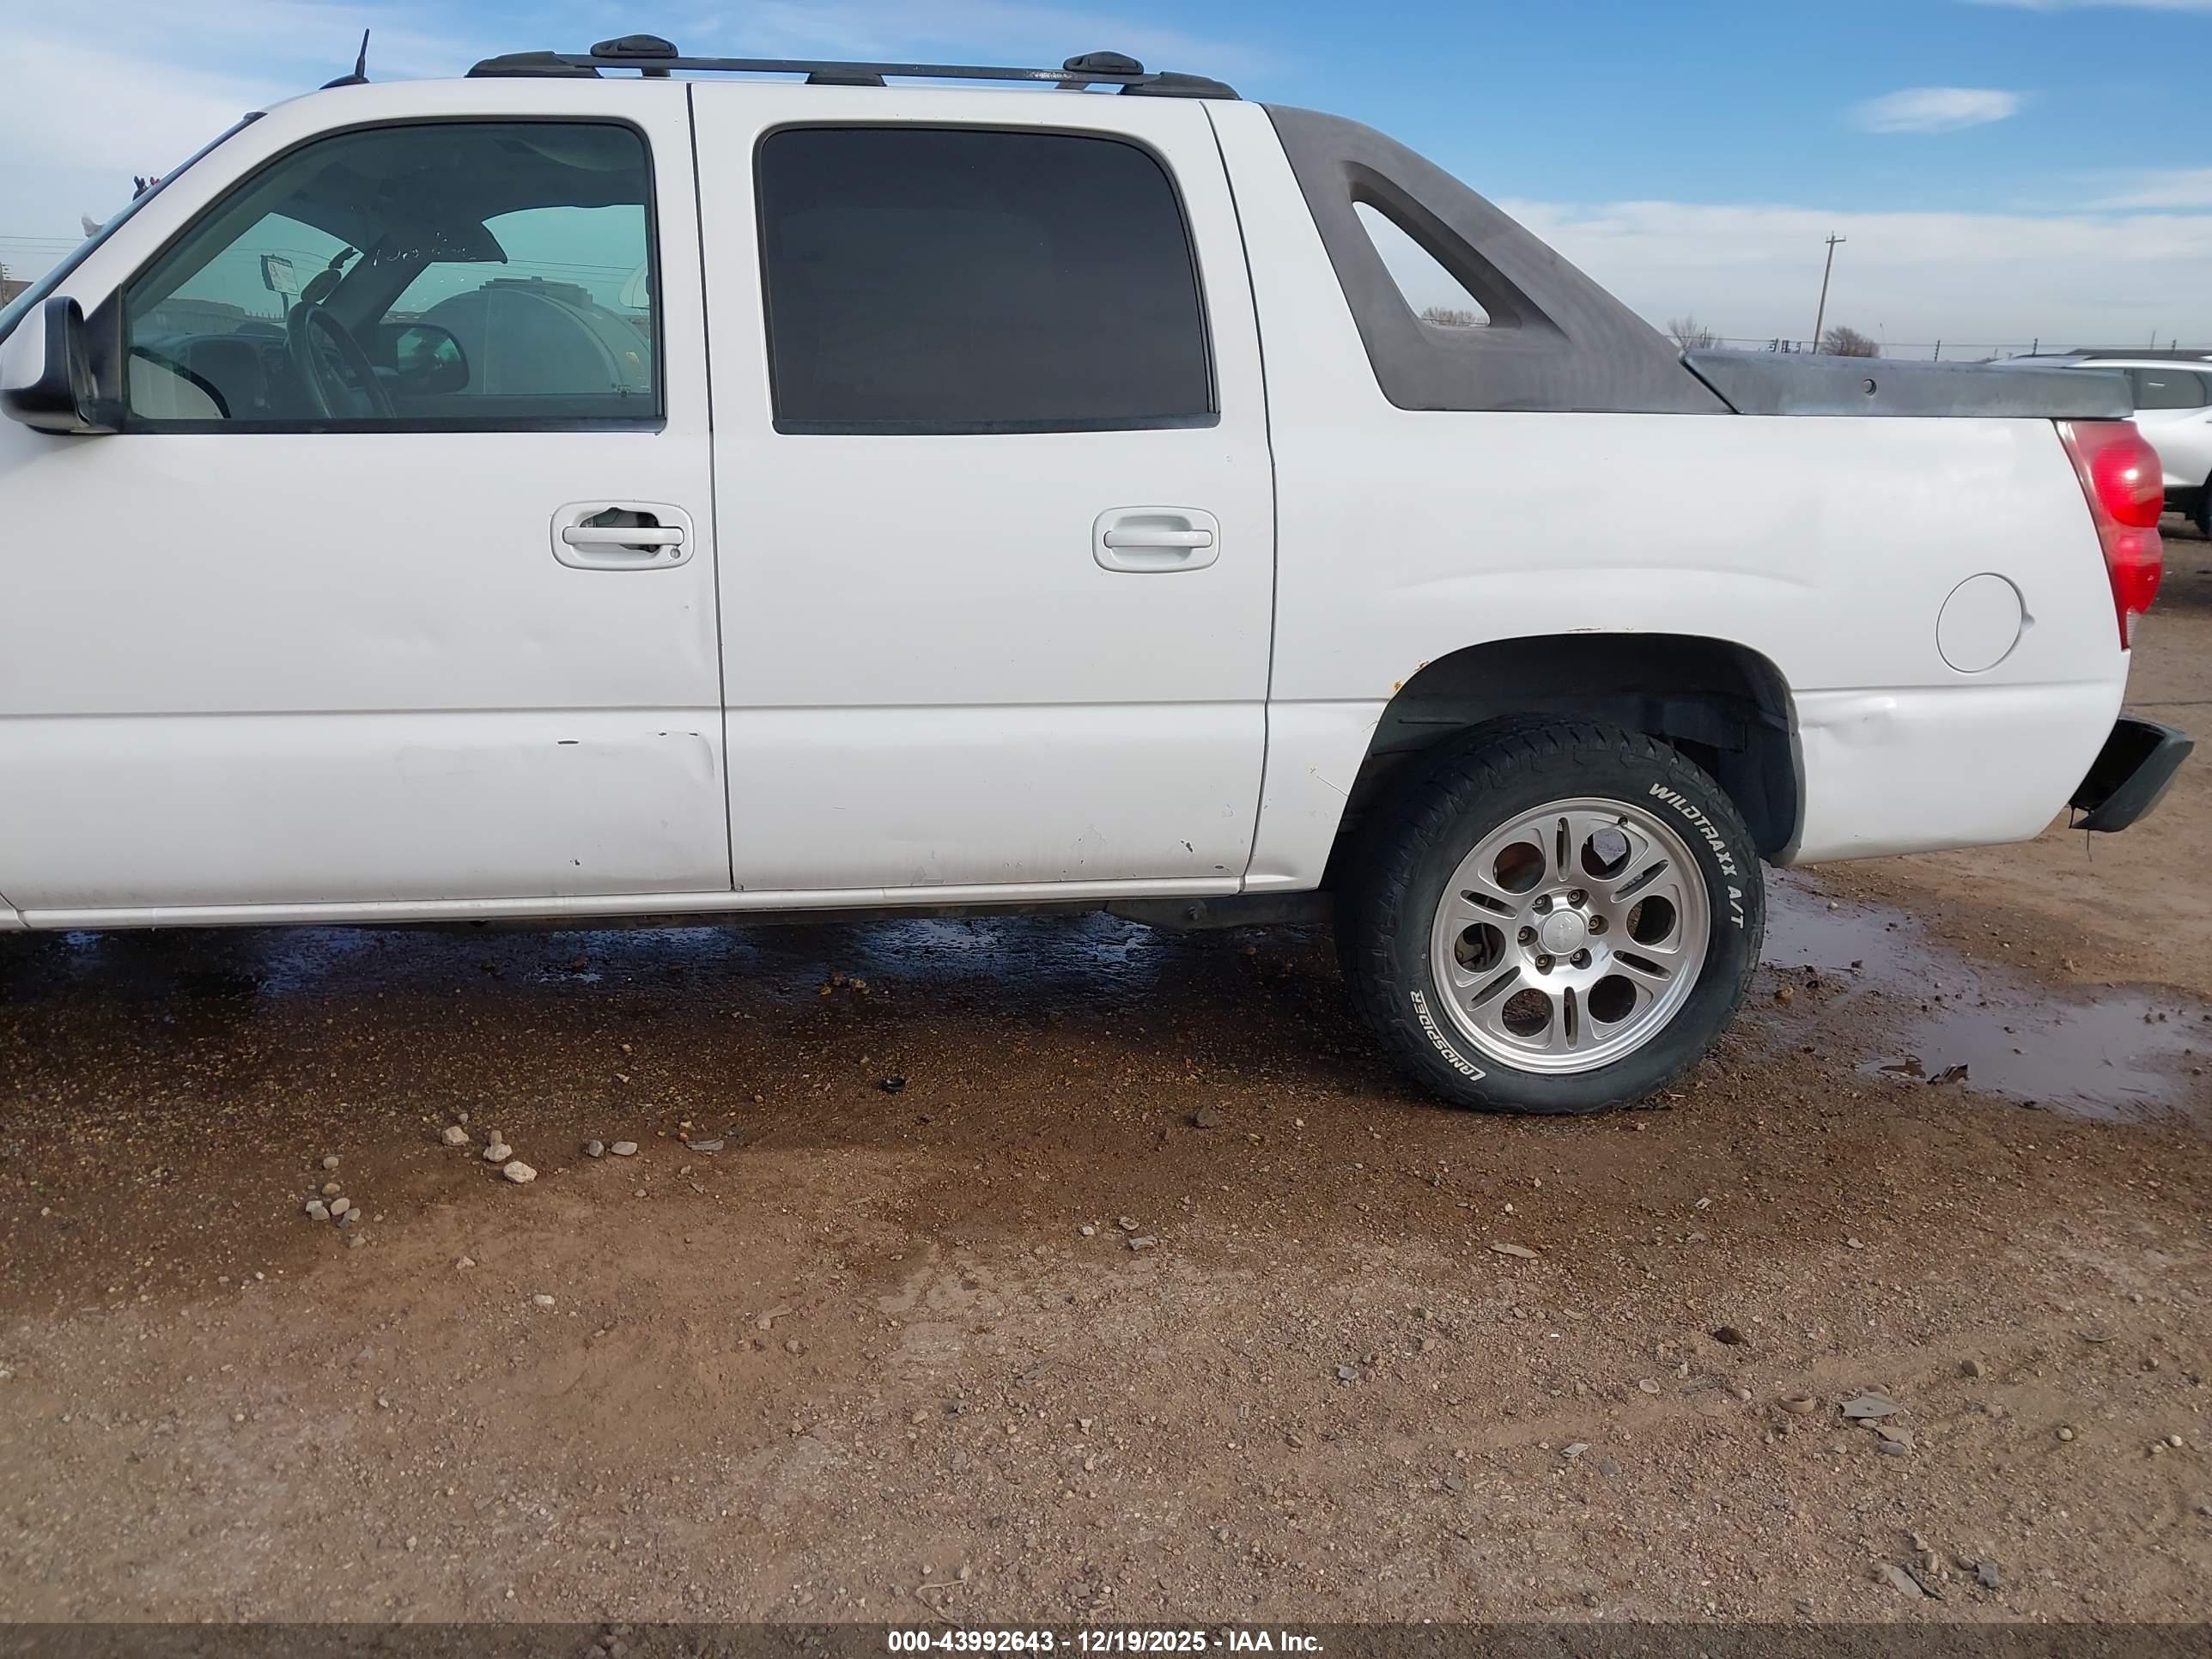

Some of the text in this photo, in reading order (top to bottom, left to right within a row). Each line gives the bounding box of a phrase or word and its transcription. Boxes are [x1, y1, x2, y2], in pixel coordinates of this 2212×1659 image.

[1648, 782, 1745, 929] WILDTRAXX A/T
[1409, 989, 1486, 1081] LANDSPIDER
